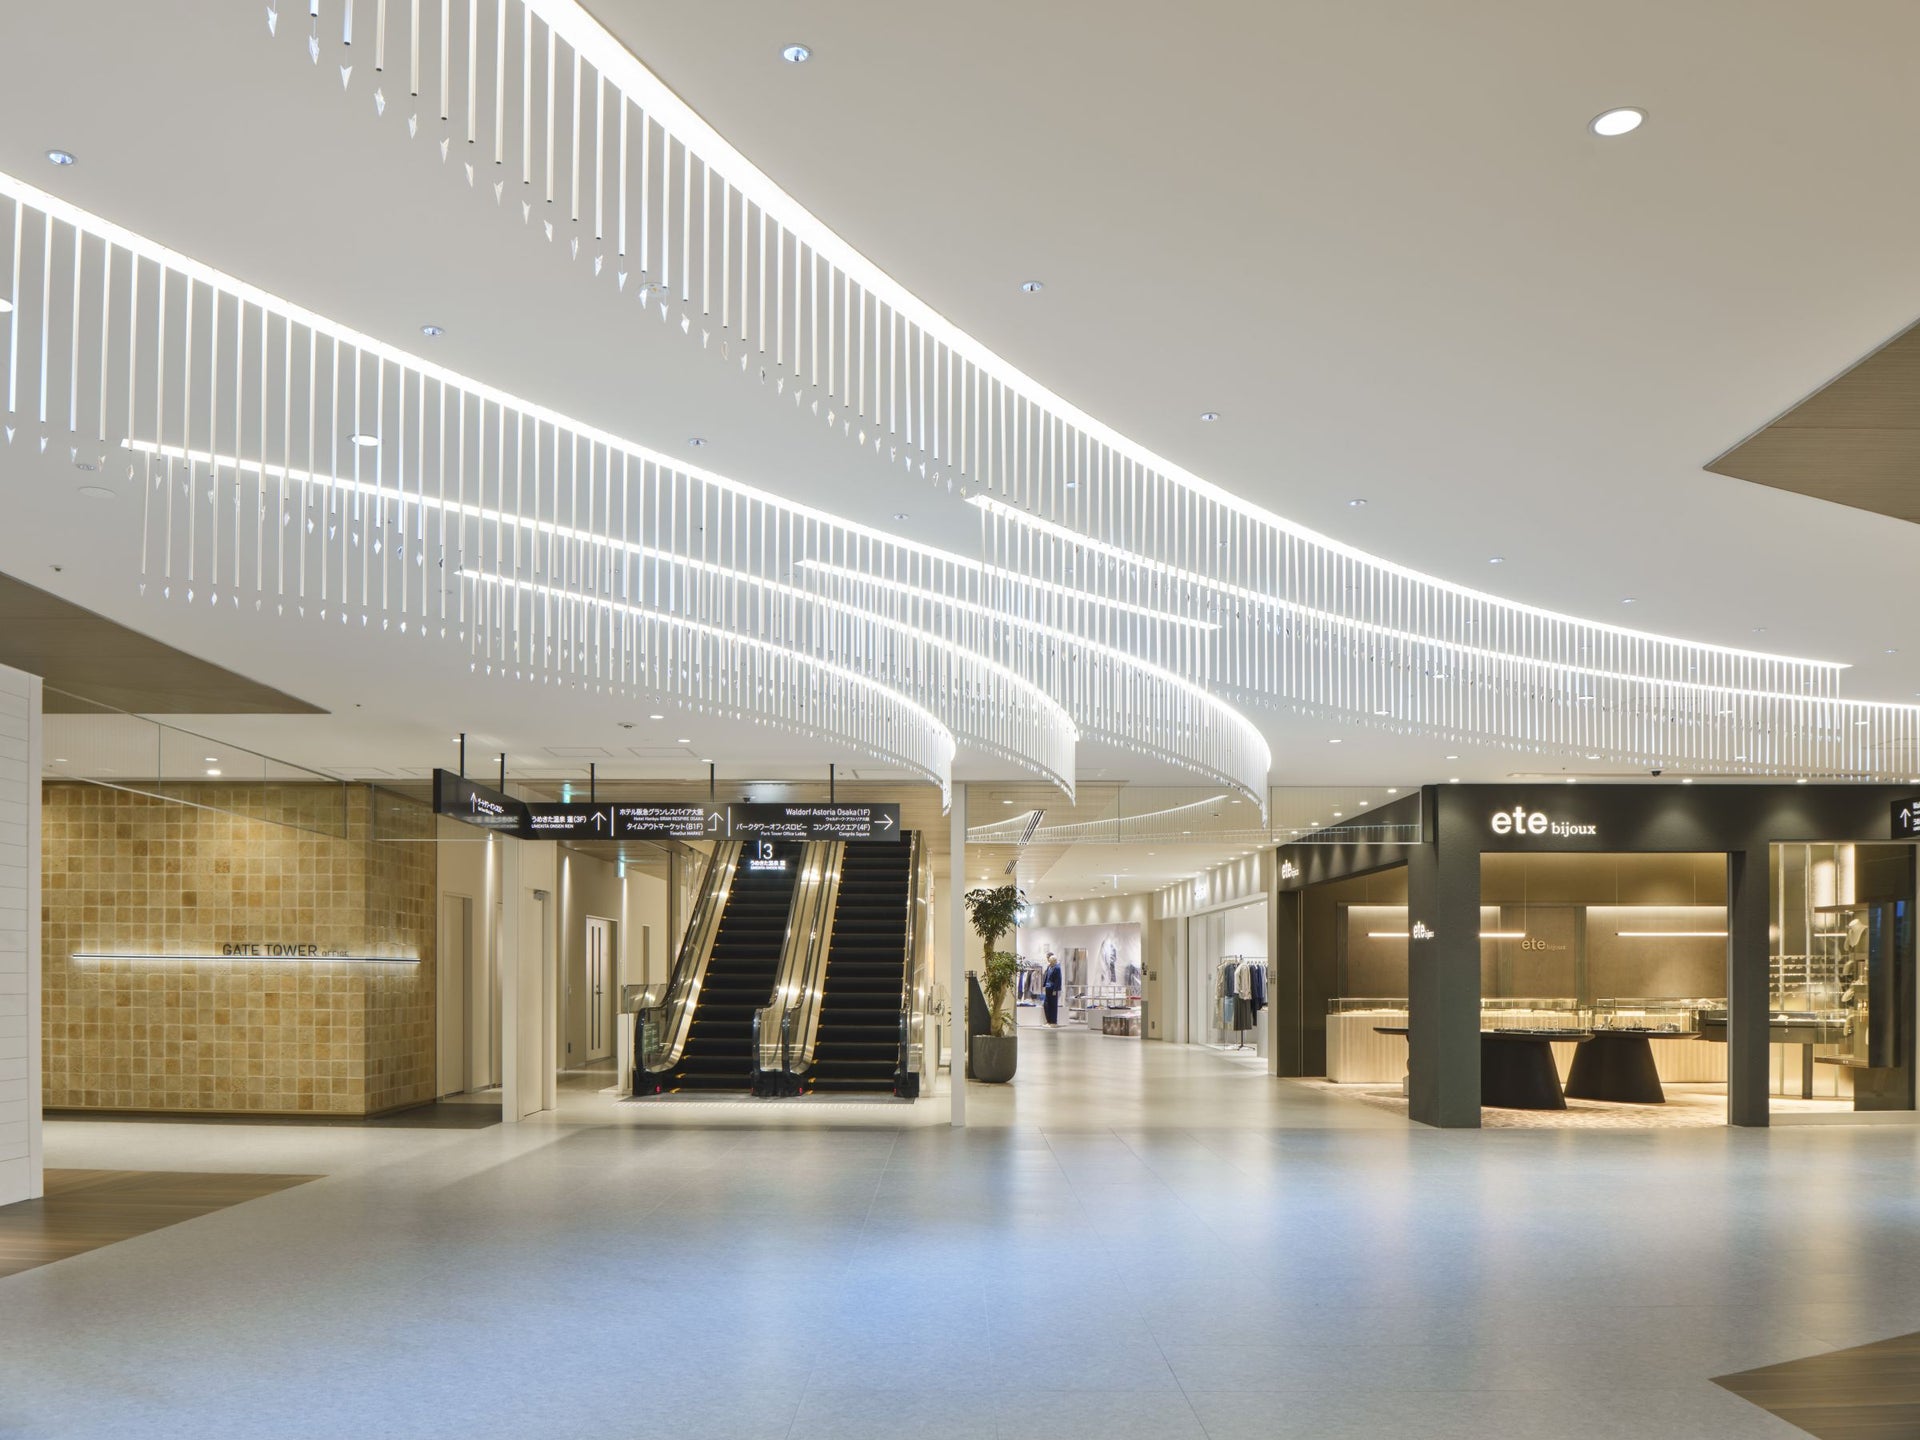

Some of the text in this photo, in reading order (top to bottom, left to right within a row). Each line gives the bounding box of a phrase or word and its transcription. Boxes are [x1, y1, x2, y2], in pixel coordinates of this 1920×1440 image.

[785, 808, 811, 816] Waldorf
[812, 808, 836, 816] Astoria
[531, 815, 566, 824] うめきた温泉
[1491, 805, 1597, 838] ete bijoux
[735, 823, 808, 831] パークタワーオフィスロビー
[763, 843, 773, 860] 3
[222, 943, 260, 957] GATE
[264, 943, 318, 957] TOWER
[1521, 938, 1546, 951] ete
